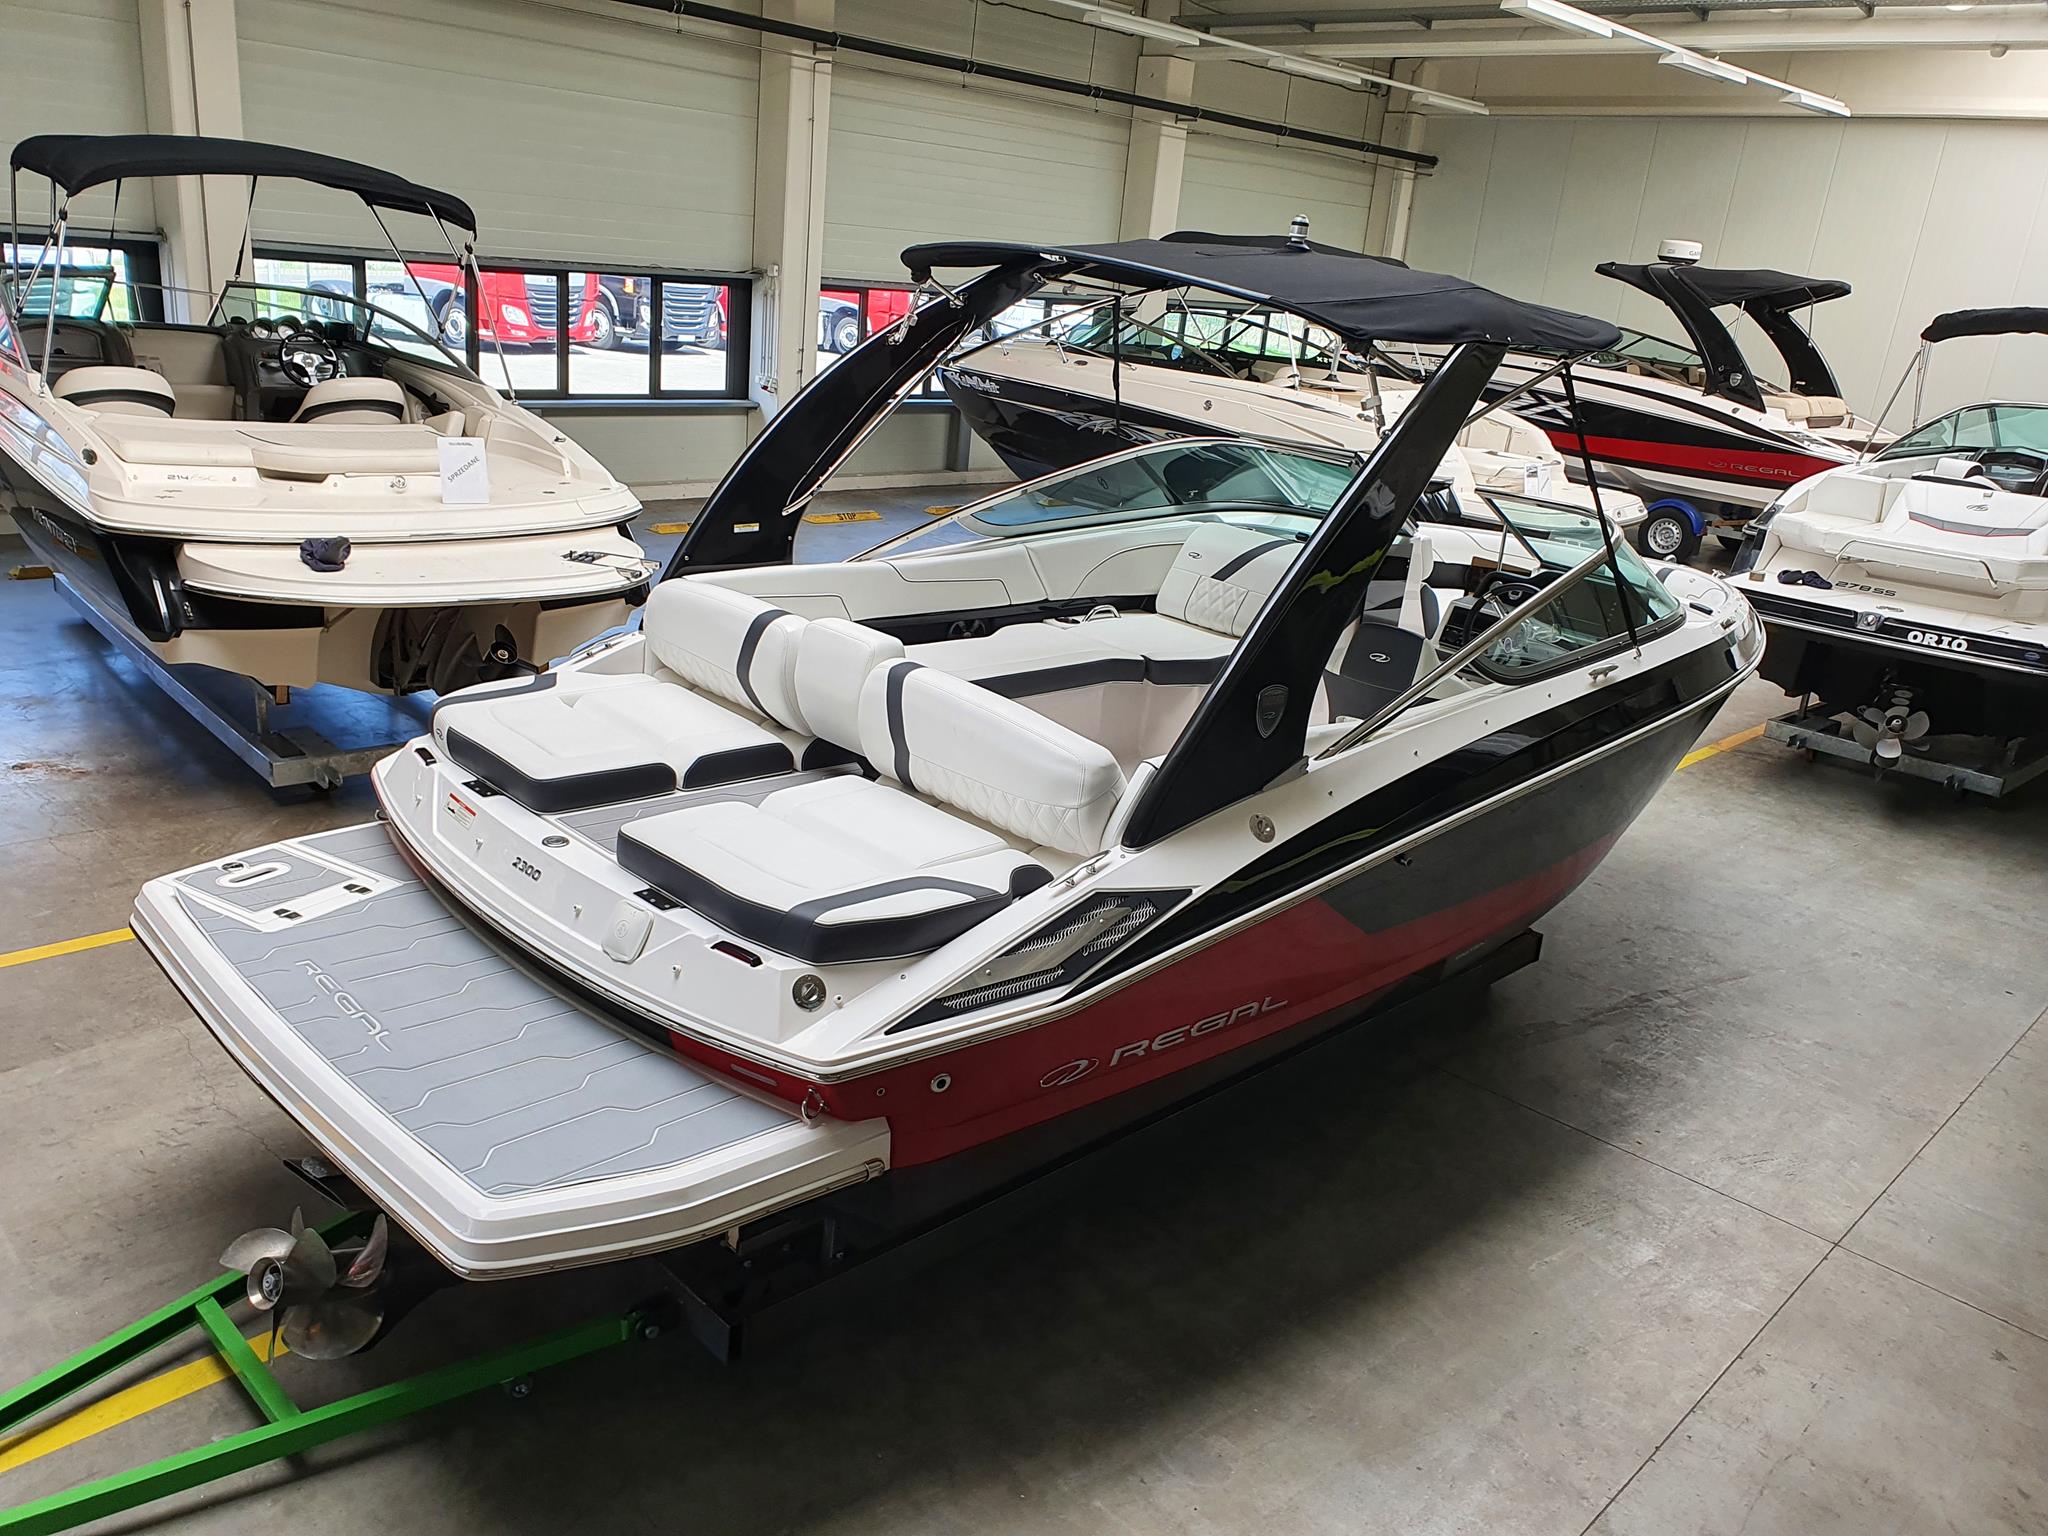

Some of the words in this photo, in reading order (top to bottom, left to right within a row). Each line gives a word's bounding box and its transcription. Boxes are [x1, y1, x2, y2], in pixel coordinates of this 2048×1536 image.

[447, 456, 480, 482] SPRZEDANE
[1730, 463, 1801, 478] REGAL
[836, 512, 857, 521] STOP
[512, 856, 542, 881] 2300
[294, 959, 392, 1053] REGAL
[1110, 996, 1289, 1067] REGAL
